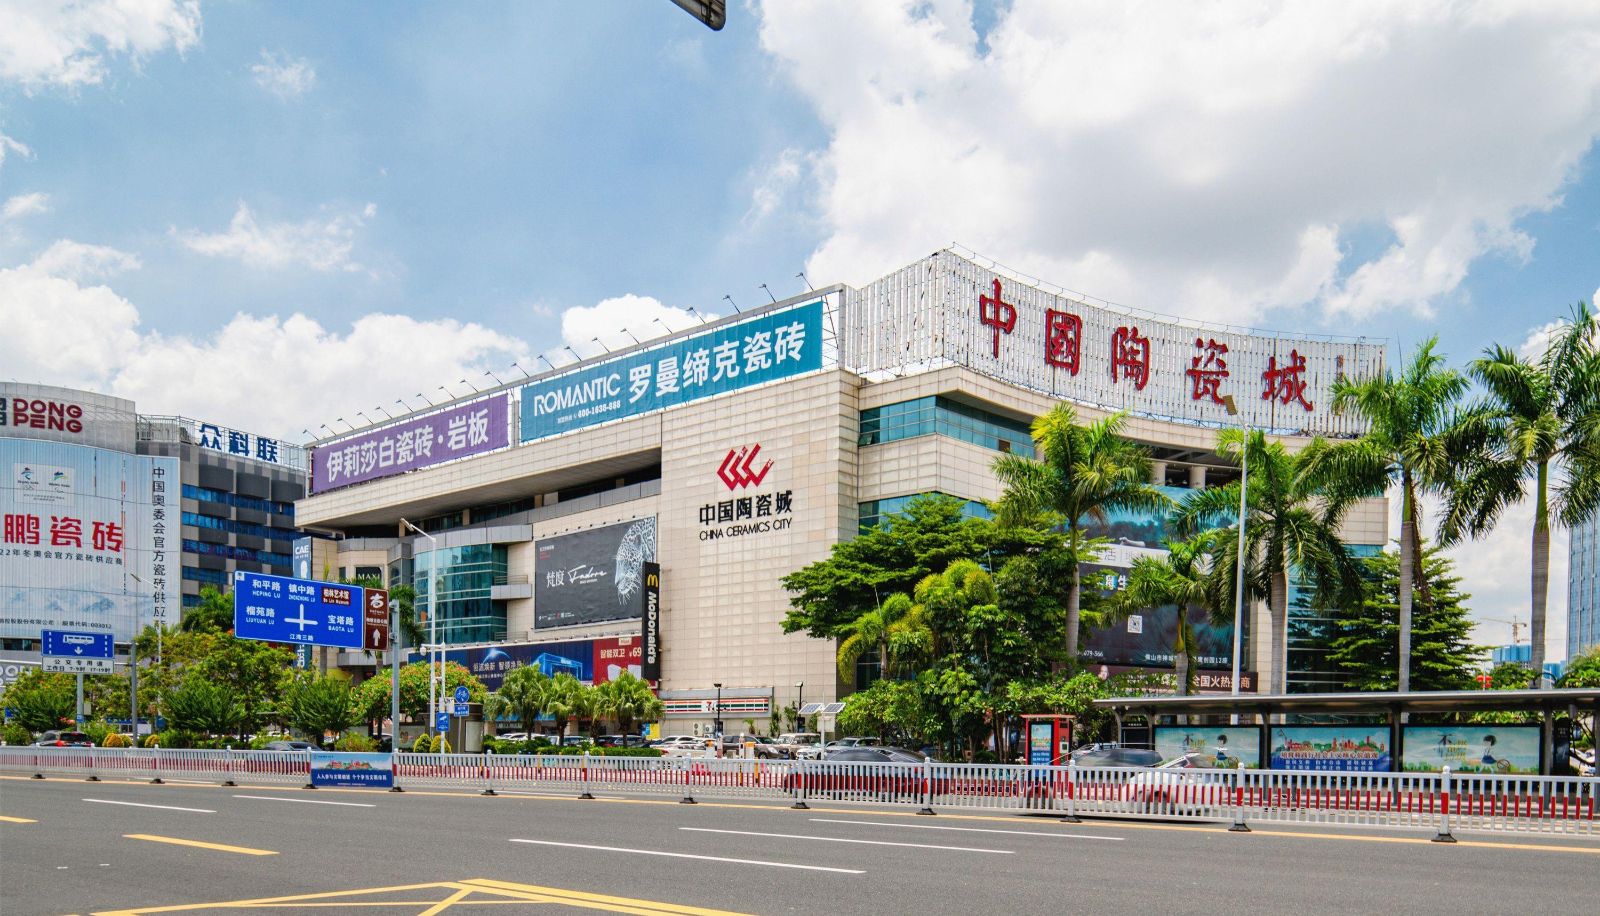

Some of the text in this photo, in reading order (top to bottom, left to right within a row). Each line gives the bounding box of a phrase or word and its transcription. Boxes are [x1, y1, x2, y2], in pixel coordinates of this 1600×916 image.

[628, 321, 806, 405] 罗曼缔克瓷砖
[534, 373, 621, 417] ROMANTIC
[13, 398, 82, 419] DONG
[13, 412, 83, 433] PENG
[199, 423, 278, 462] 众科联
[699, 490, 792, 526] 中国陶瓷城
[4, 513, 123, 552] 鹏瓷砖
[699, 517, 793, 541] CHINA CERAMICS CITY
[295, 545, 309, 555] CAE
[252, 580, 281, 592] 和平路
[288, 583, 315, 596] 镇中路
[327, 614, 354, 626] 宝塔路
[1192, 675, 1250, 689] 全国火热商
